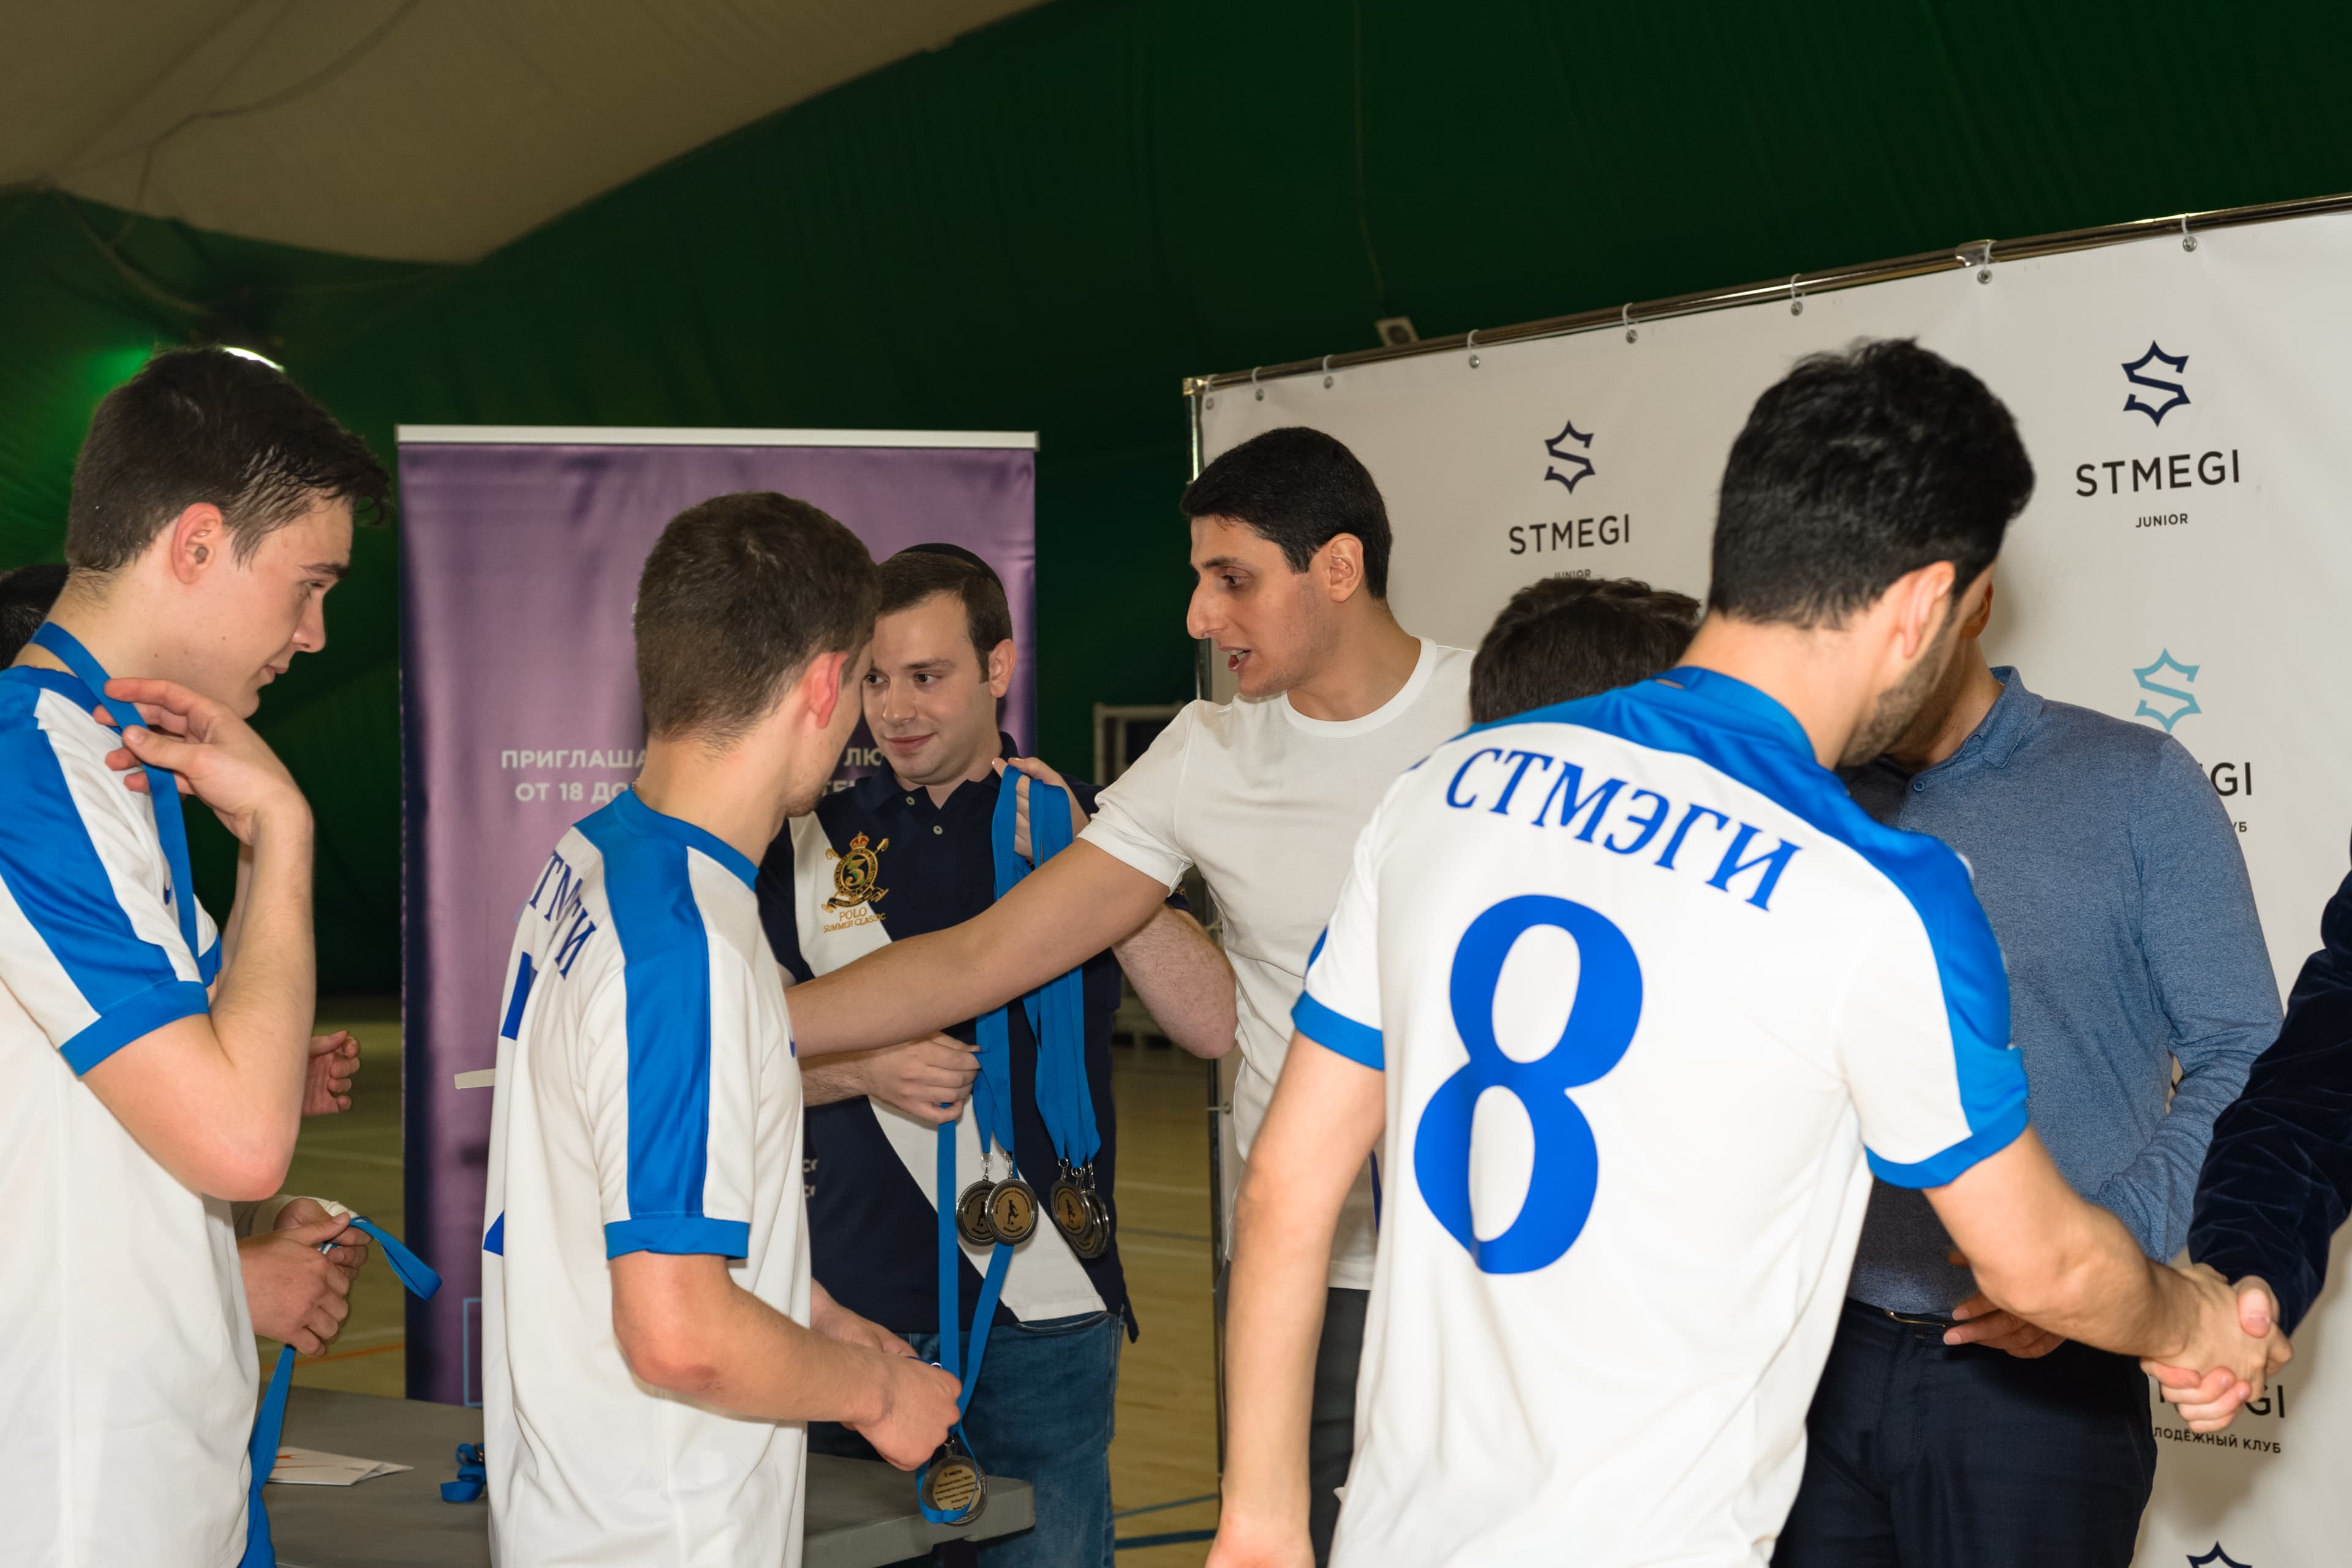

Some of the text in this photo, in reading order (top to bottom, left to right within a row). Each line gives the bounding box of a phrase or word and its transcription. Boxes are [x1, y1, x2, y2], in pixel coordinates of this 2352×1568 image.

[2075, 448, 2240, 497] STMEGI
[2135, 513, 2189, 528] JUNIOR
[1508, 513, 1630, 555] STMEGI
[514, 782, 550, 802] ОТ
[558, 781, 584, 801] 18
[1444, 748, 1804, 912] СТМЭГИ
[823, 912, 887, 933] SUMMER CLASSIC
[839, 906, 868, 922] POLO
[1413, 894, 1643, 1275] 8
[2242, 1438, 2282, 1454] КЛУБ
